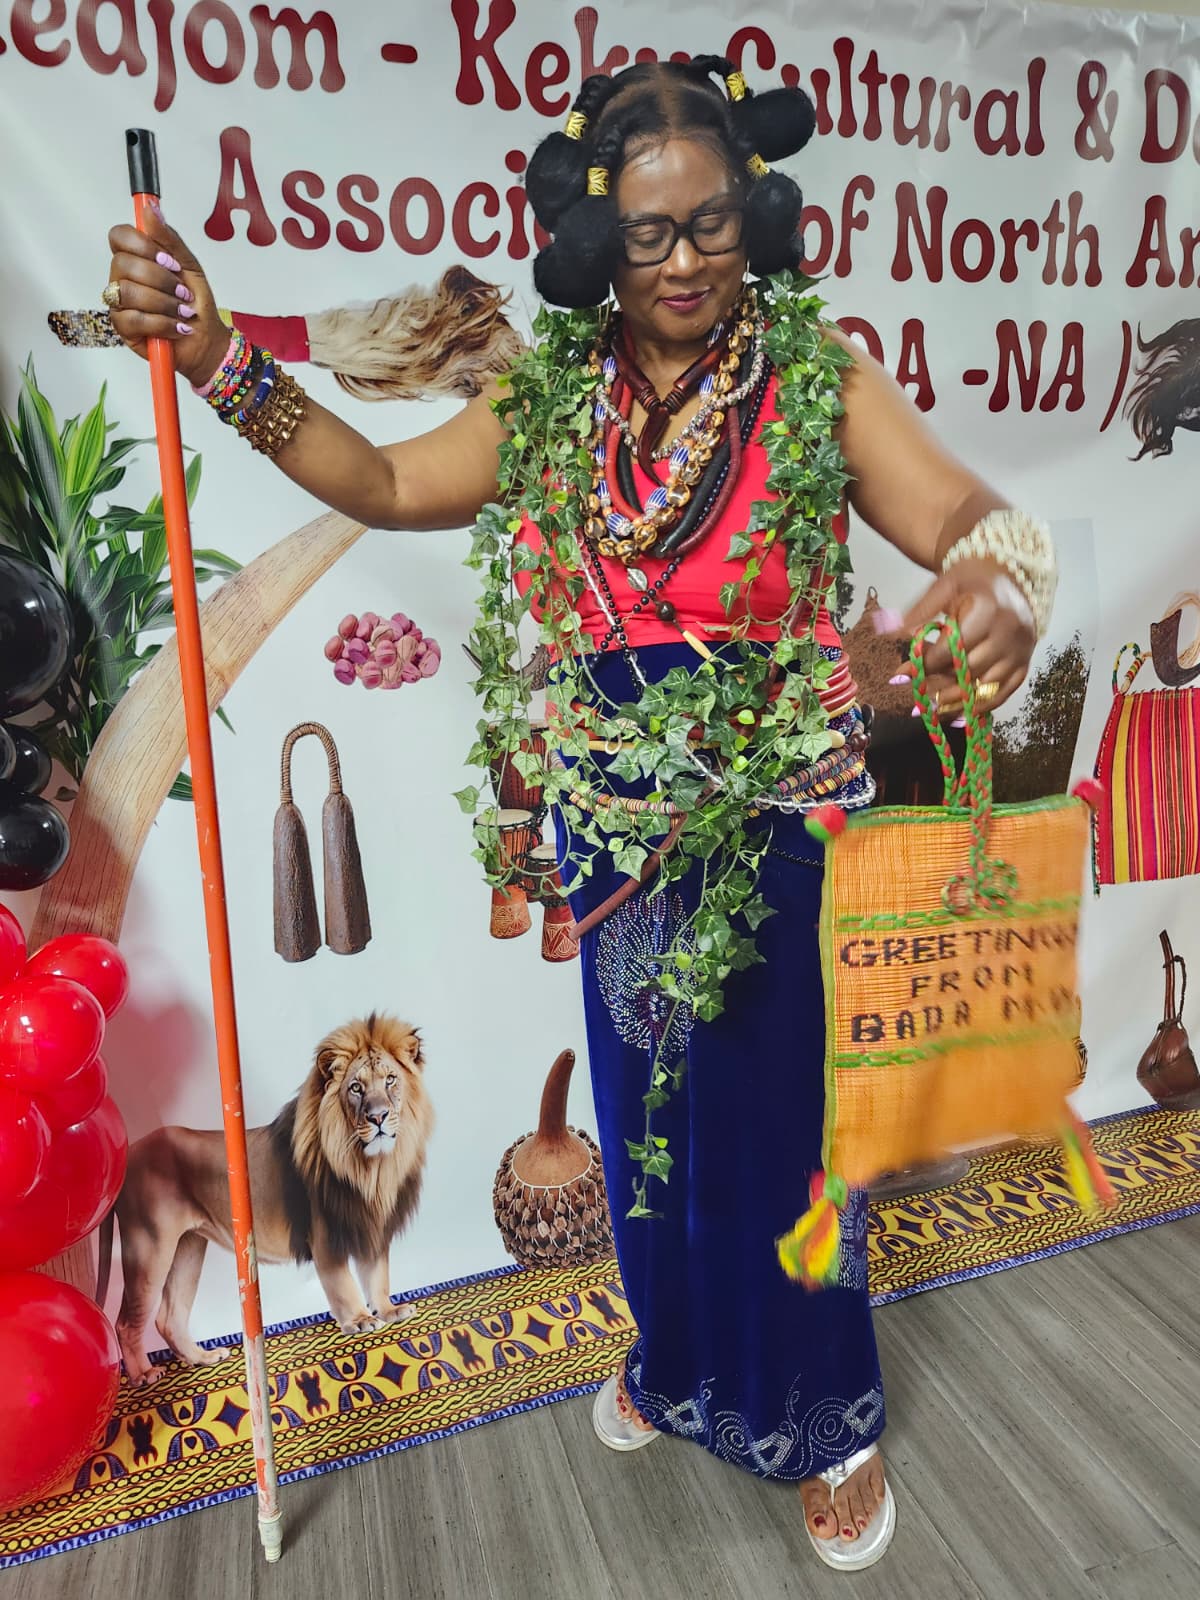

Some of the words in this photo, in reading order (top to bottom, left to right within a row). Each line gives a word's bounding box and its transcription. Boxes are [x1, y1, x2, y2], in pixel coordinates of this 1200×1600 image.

[0, 0, 345, 112] edjom
[451, 0, 692, 118] Kek
[1074, 60, 1119, 163] &
[1140, 68, 1200, 164] D
[204, 126, 554, 260] Associ
[798, 174, 875, 278] of
[890, 181, 1102, 288] North
[840, 922, 1079, 968] GREETIN
